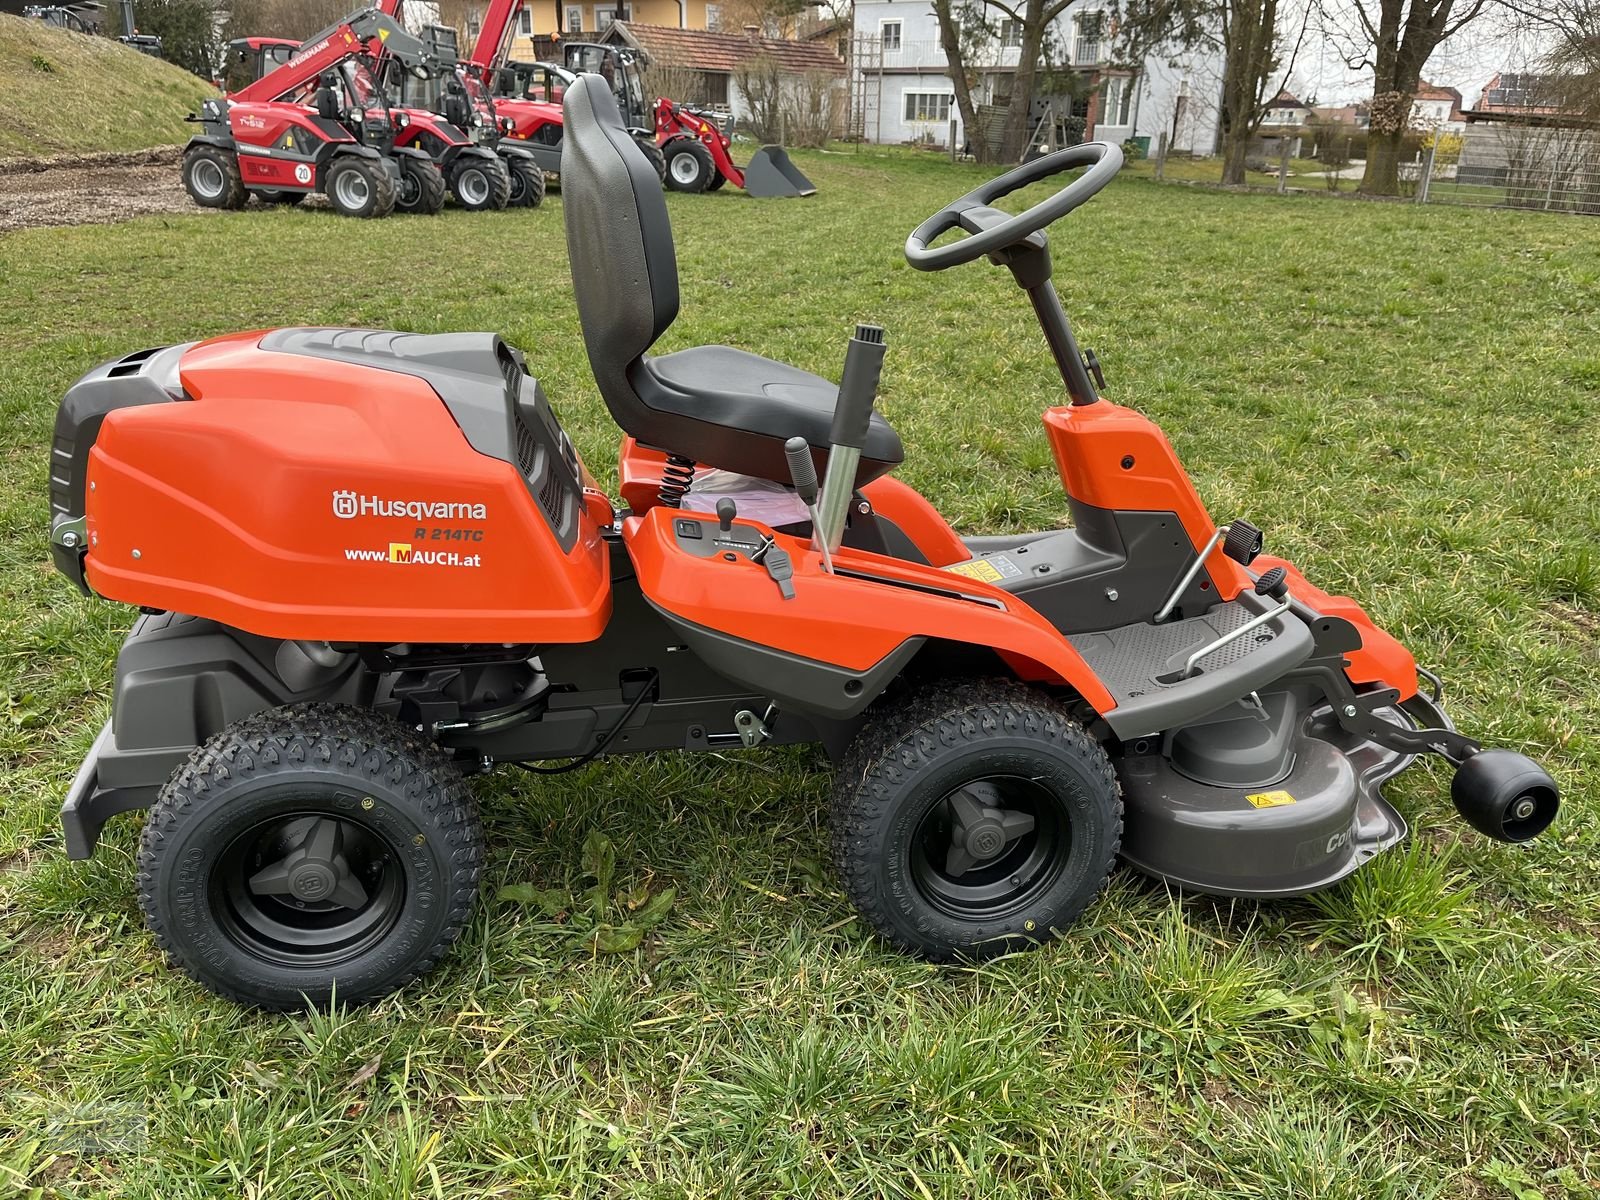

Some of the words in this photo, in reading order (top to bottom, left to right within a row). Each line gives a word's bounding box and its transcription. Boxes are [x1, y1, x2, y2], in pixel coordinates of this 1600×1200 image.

[287, 39, 330, 69] WEIDEMANN
[298, 167, 309, 180] 20
[360, 495, 487, 521] Husqvarna
[414, 527, 427, 540] R
[431, 528, 484, 542] 214TC
[344, 547, 481, 567] www.MAUCH.at
